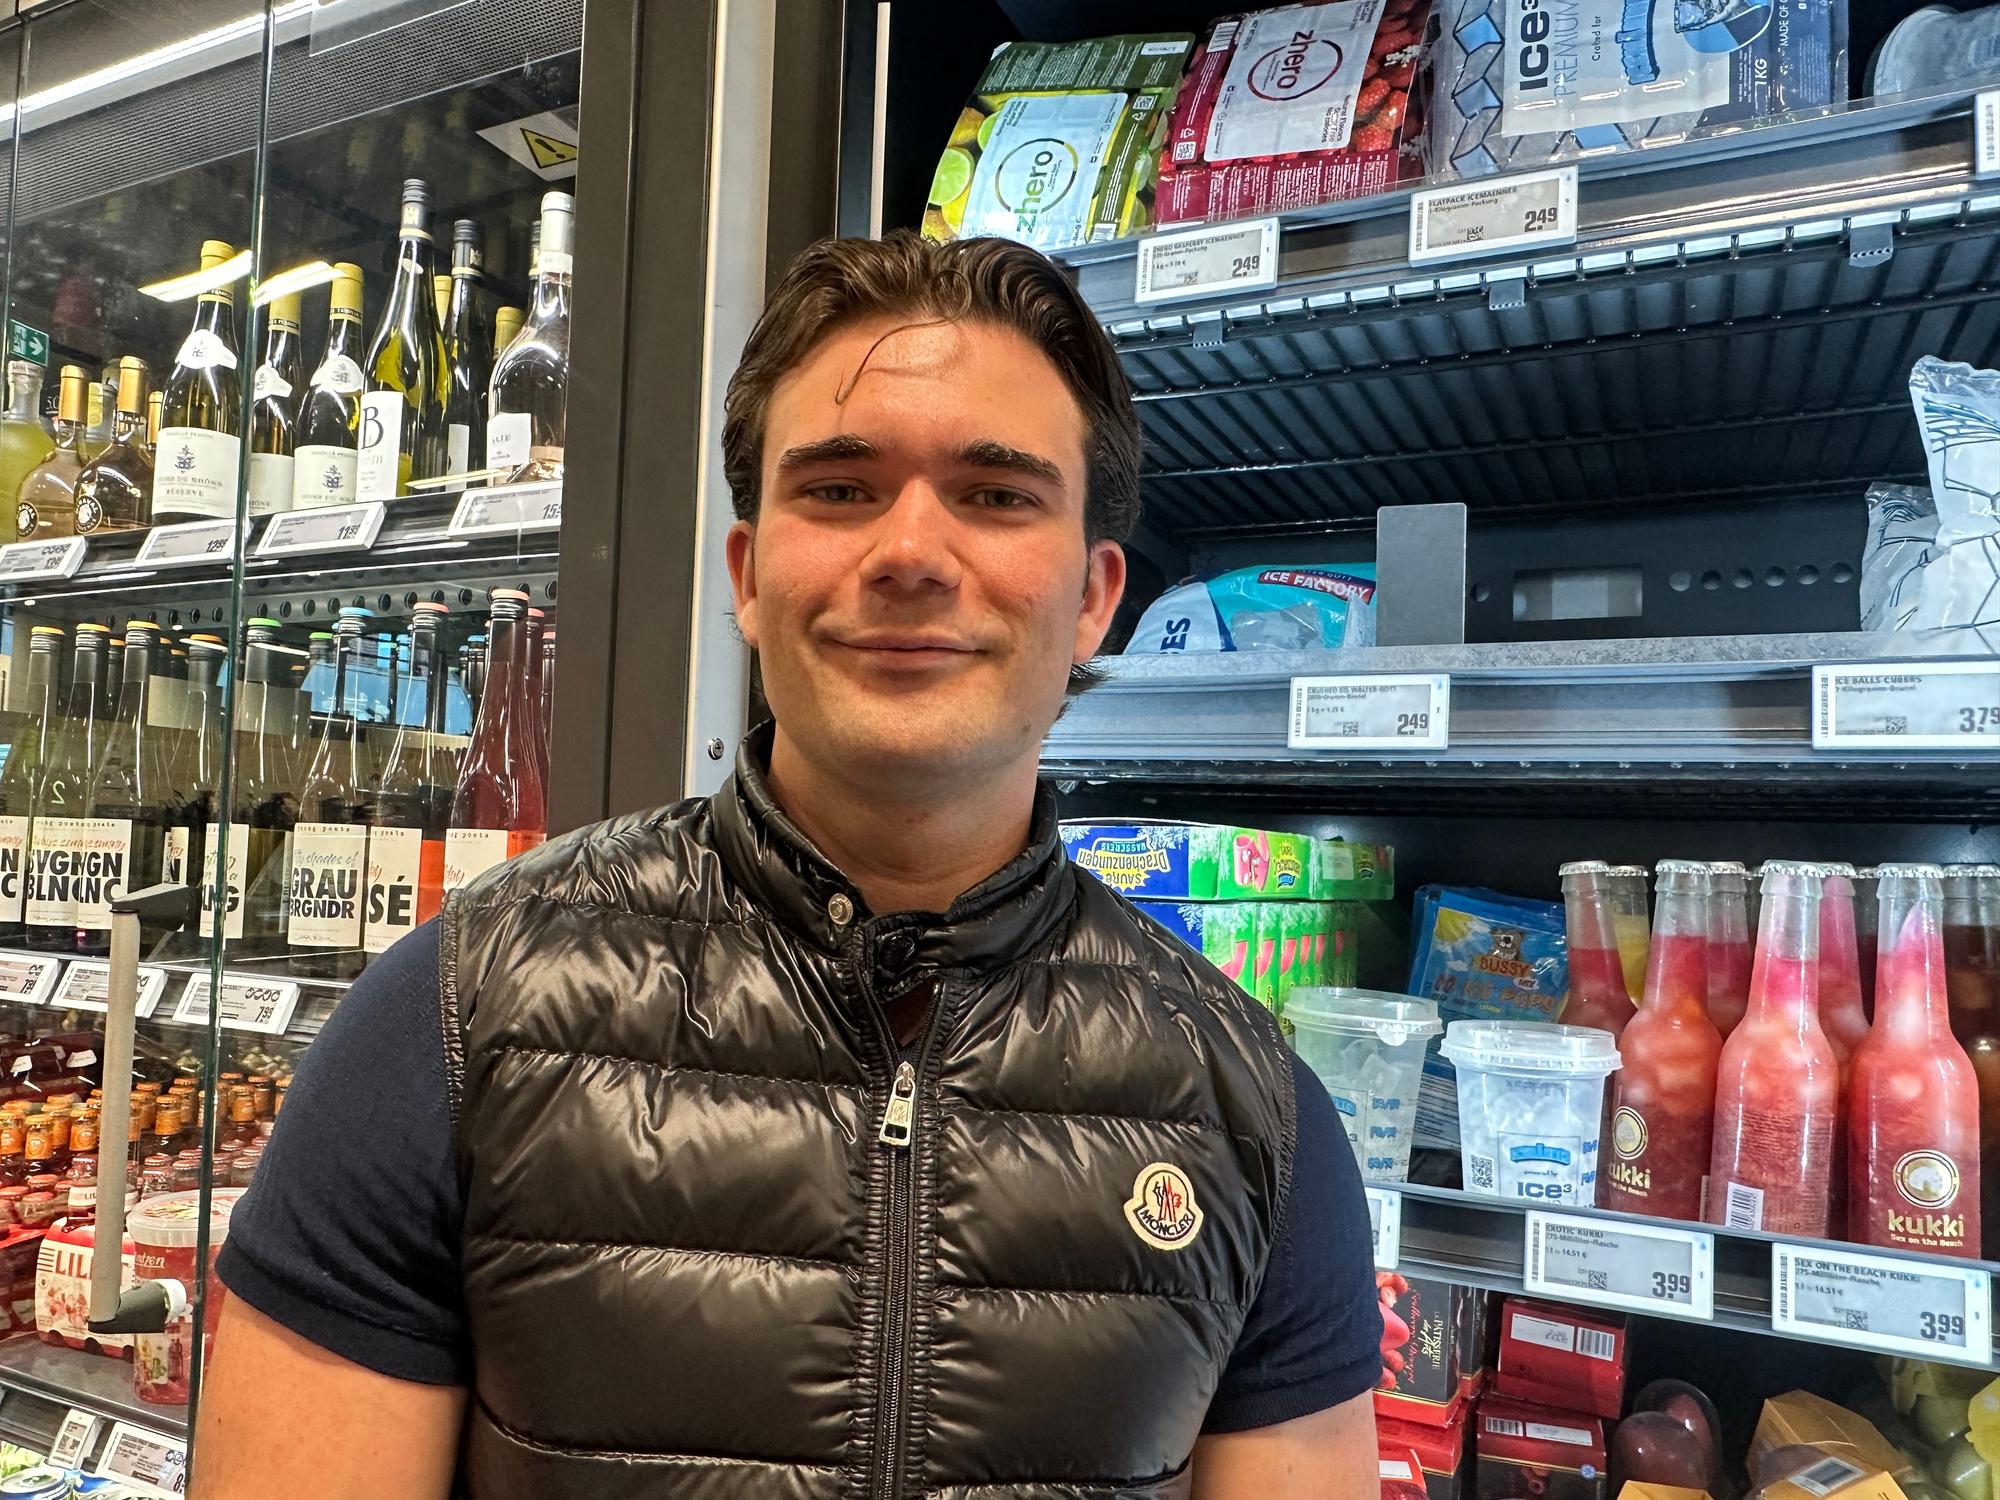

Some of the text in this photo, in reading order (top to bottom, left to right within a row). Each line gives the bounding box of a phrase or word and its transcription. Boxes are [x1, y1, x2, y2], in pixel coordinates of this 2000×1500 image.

[1779, 6, 1789, 46] MADE OF
[1276, 30, 1318, 90] zhero
[1014, 151, 1053, 233] zhero
[361, 406, 384, 449] B
[1264, 571, 1369, 599] ICE FACTORY
[1160, 617, 1191, 654] ES
[1079, 850, 1168, 871] Drachenzungen
[292, 867, 358, 899] GRAU
[1479, 956, 1530, 978] BUSSY
[1139, 1209, 1193, 1236] MONCLER
[1545, 1223, 1603, 1239] EXOTIC KUKKI
[1888, 1209, 1964, 1237] kukki
[1939, 1239, 1964, 1247] Beach
[1795, 1257, 1813, 1269] SEX
[1816, 1261, 1830, 1271] ON
[1833, 1264, 1851, 1274] THE
[1854, 1267, 1887, 1279] BEACH
[1418, 1329, 1434, 1358] Arts
